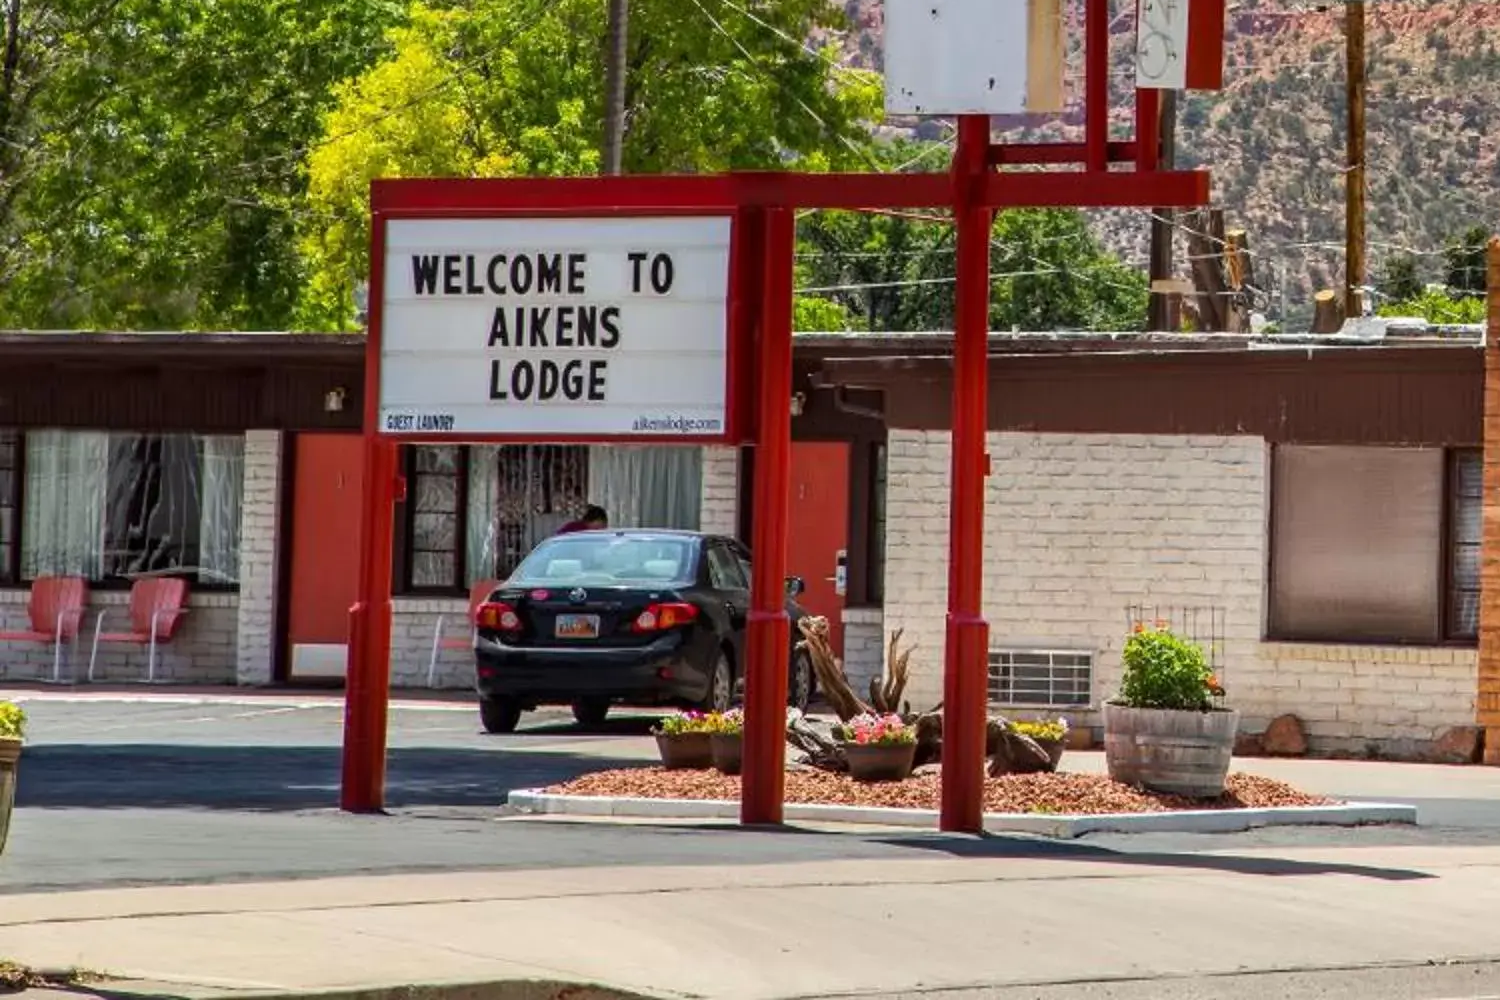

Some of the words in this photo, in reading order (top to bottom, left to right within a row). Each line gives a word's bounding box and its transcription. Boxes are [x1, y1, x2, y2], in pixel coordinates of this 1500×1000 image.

[411, 252, 587, 295] WELCOME
[627, 252, 674, 294] TO
[488, 306, 621, 348] AIKENS
[489, 359, 608, 401] LODGE
[387, 415, 414, 430] GUEST
[632, 415, 721, 432] aikenslodge.com
